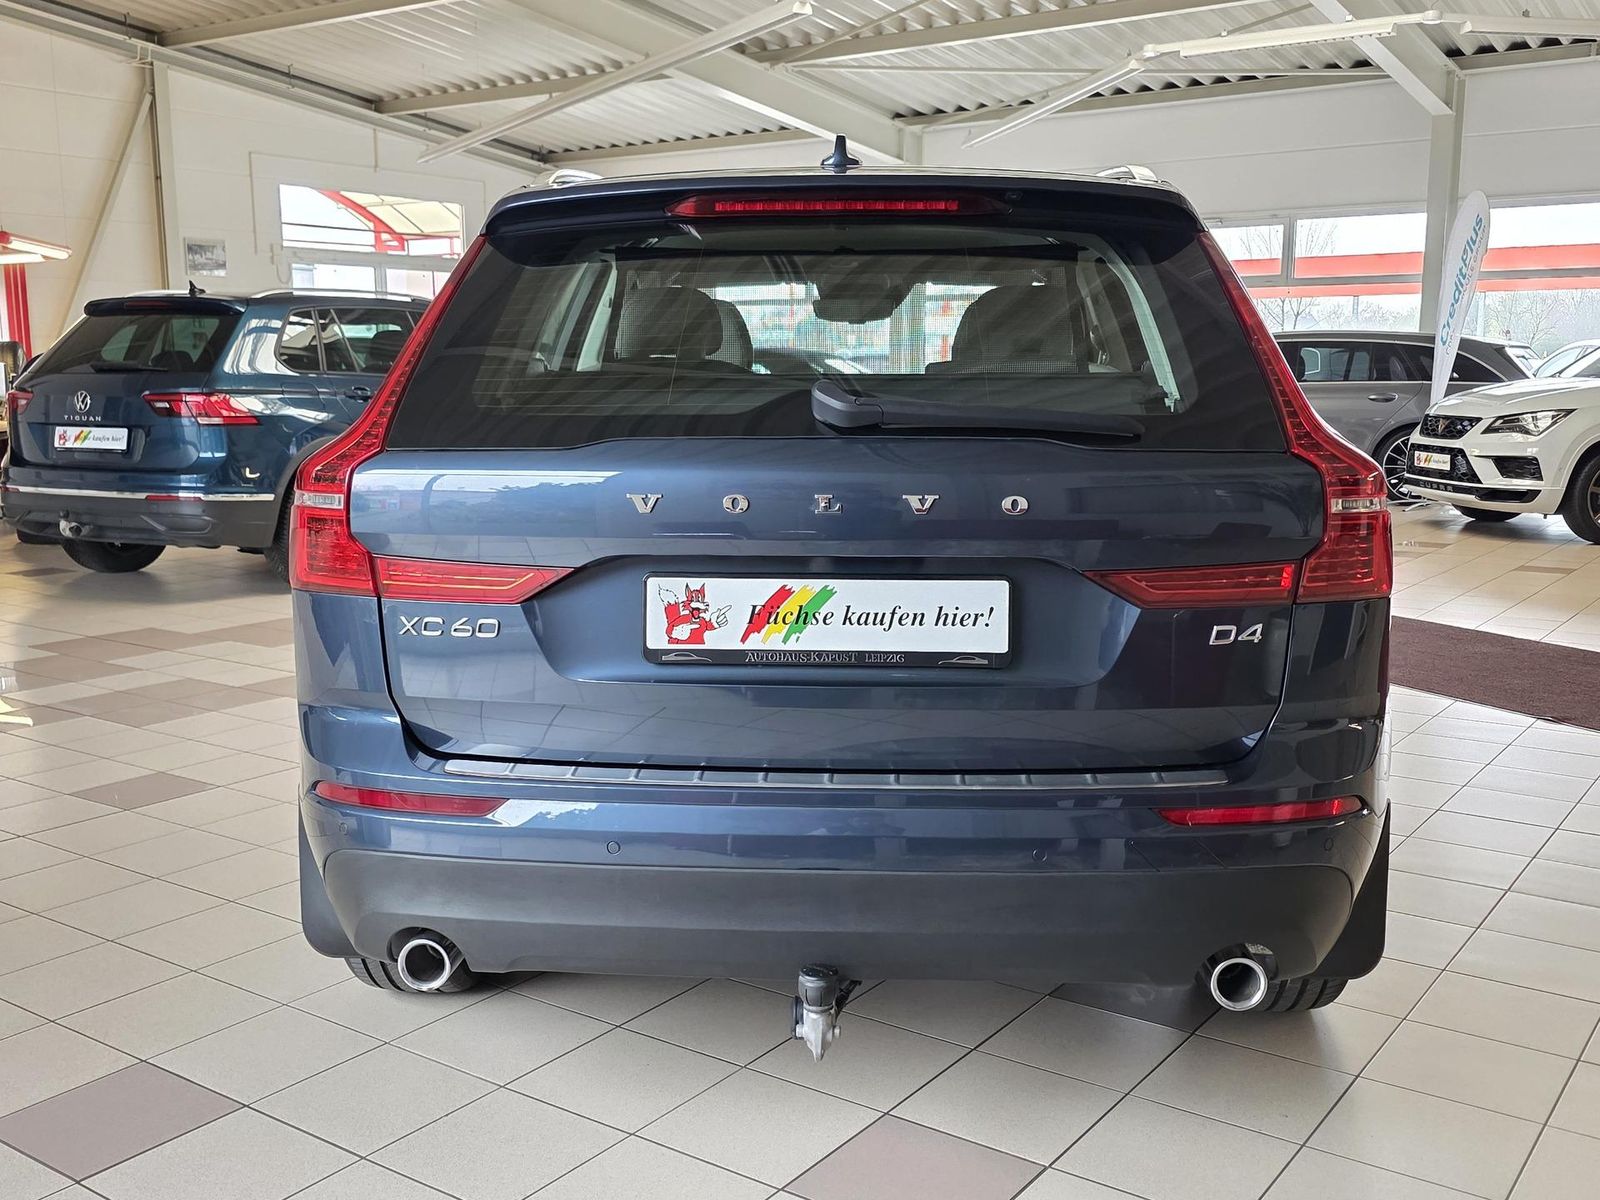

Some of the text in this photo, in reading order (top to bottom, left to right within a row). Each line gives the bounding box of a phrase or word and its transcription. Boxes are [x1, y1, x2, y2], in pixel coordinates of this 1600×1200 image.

[1440, 214, 1483, 346] CreditPlus
[627, 493, 1030, 515] VOLVO
[747, 604, 995, 632] Füchse kaufen hier!
[1209, 623, 1264, 645] D4
[865, 653, 905, 663] LEIPZIG
